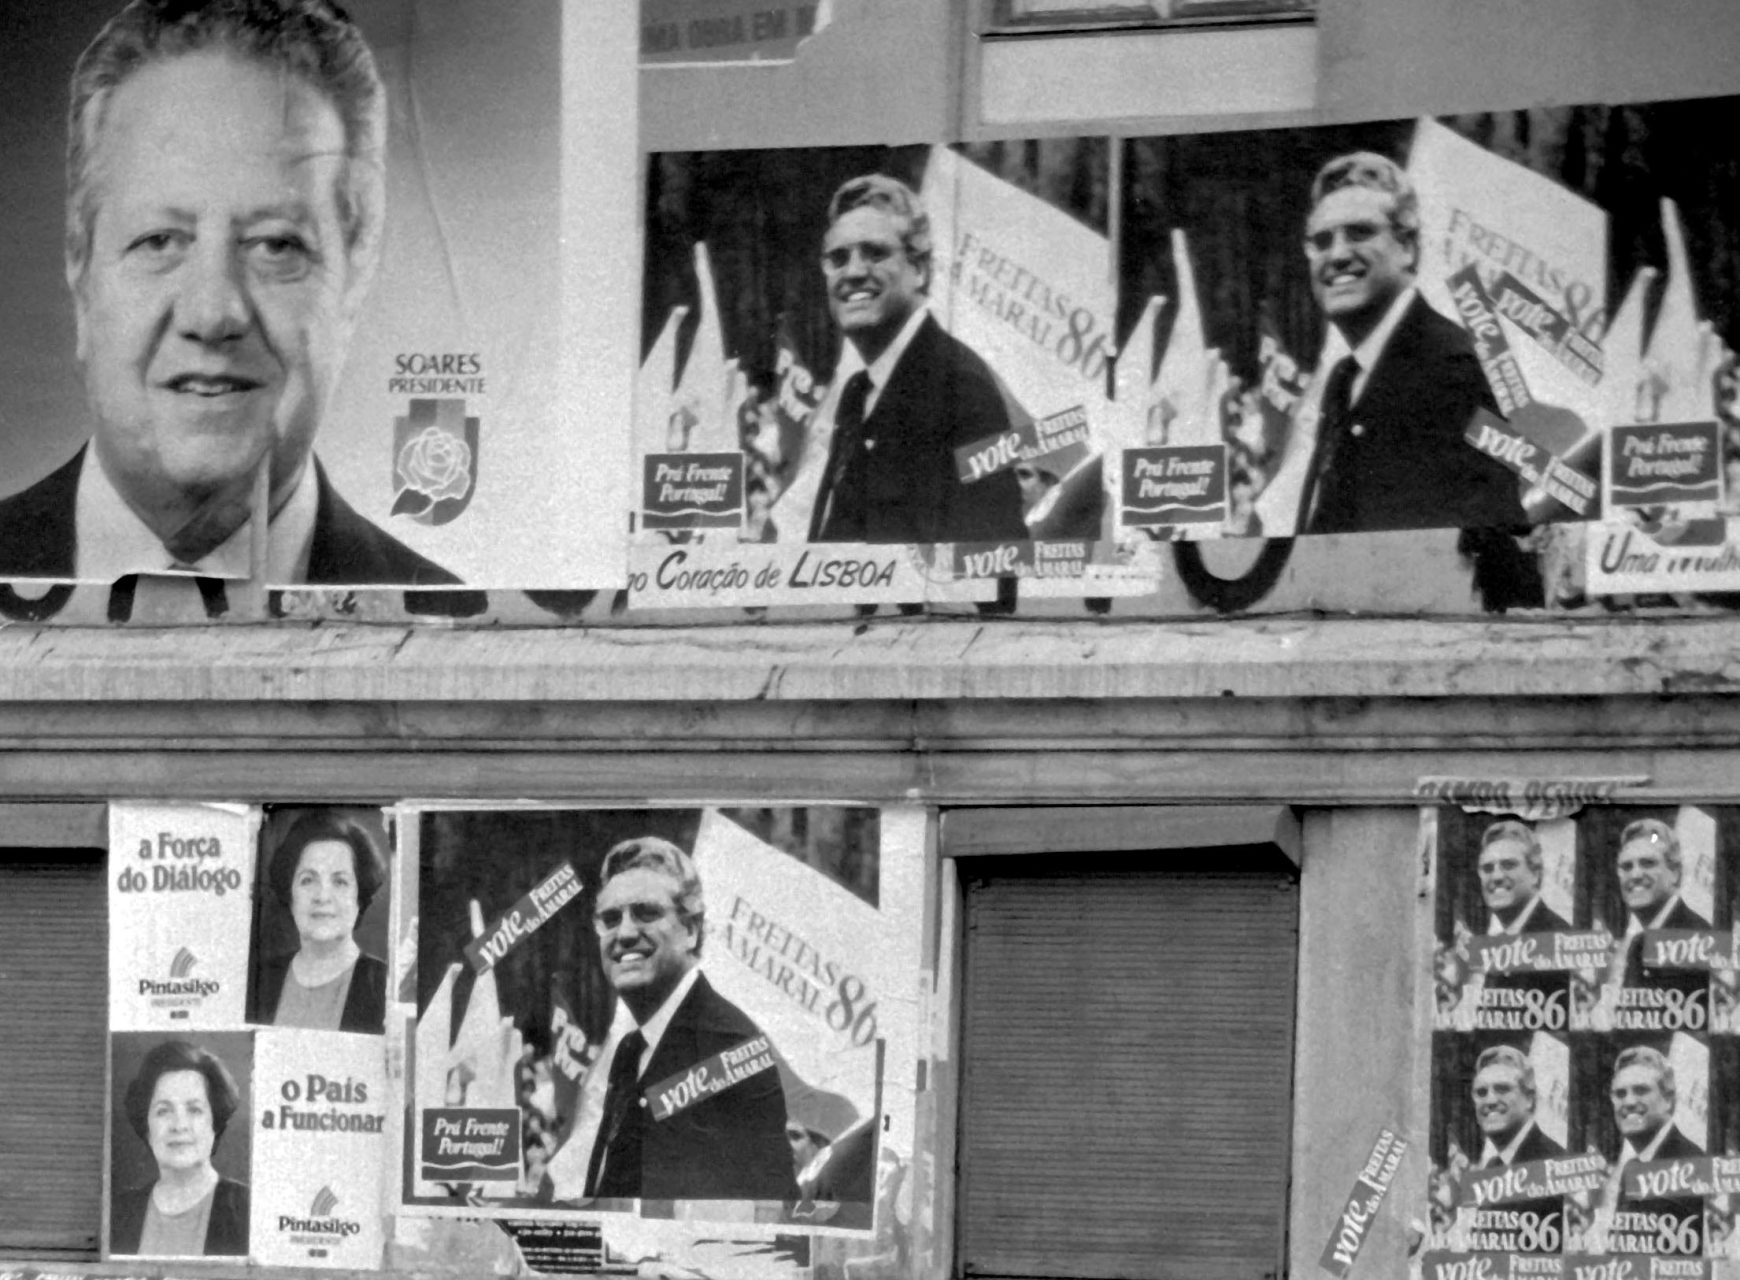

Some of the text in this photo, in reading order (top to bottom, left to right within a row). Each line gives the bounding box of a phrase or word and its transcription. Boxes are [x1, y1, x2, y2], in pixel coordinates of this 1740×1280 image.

[395, 353, 480, 375] SOARES
[389, 378, 485, 394] PRESIDENTE
[656, 550, 750, 596] Coração
[753, 558, 782, 589] de
[788, 550, 897, 589] LISBOA
[962, 546, 1019, 579] vote
[139, 832, 221, 862] a Força
[118, 864, 241, 896] do Diálogo
[478, 863, 576, 966] vote FREITAS
[1480, 936, 1539, 968] vote
[1655, 935, 1716, 966] vote
[139, 979, 220, 998] Pintasilgo
[826, 974, 879, 1047] 86
[1523, 988, 1568, 1031] 86
[1662, 988, 1707, 1031] 86
[281, 1079, 301, 1102] o
[660, 1062, 710, 1116] vote
[262, 1105, 384, 1134] a Funcionar
[464, 1119, 510, 1137] Frente
[1472, 1156, 1600, 1204] vote FREITAS
[1636, 1162, 1695, 1197] vote
[279, 1215, 360, 1236] Pintasilgo
[1332, 1198, 1370, 1267] vote
[1517, 1211, 1561, 1253] 86
[1656, 1213, 1700, 1255] 86
[1508, 1254, 1562, 1274] FREITAS
[1650, 1256, 1704, 1276] FREITAS
